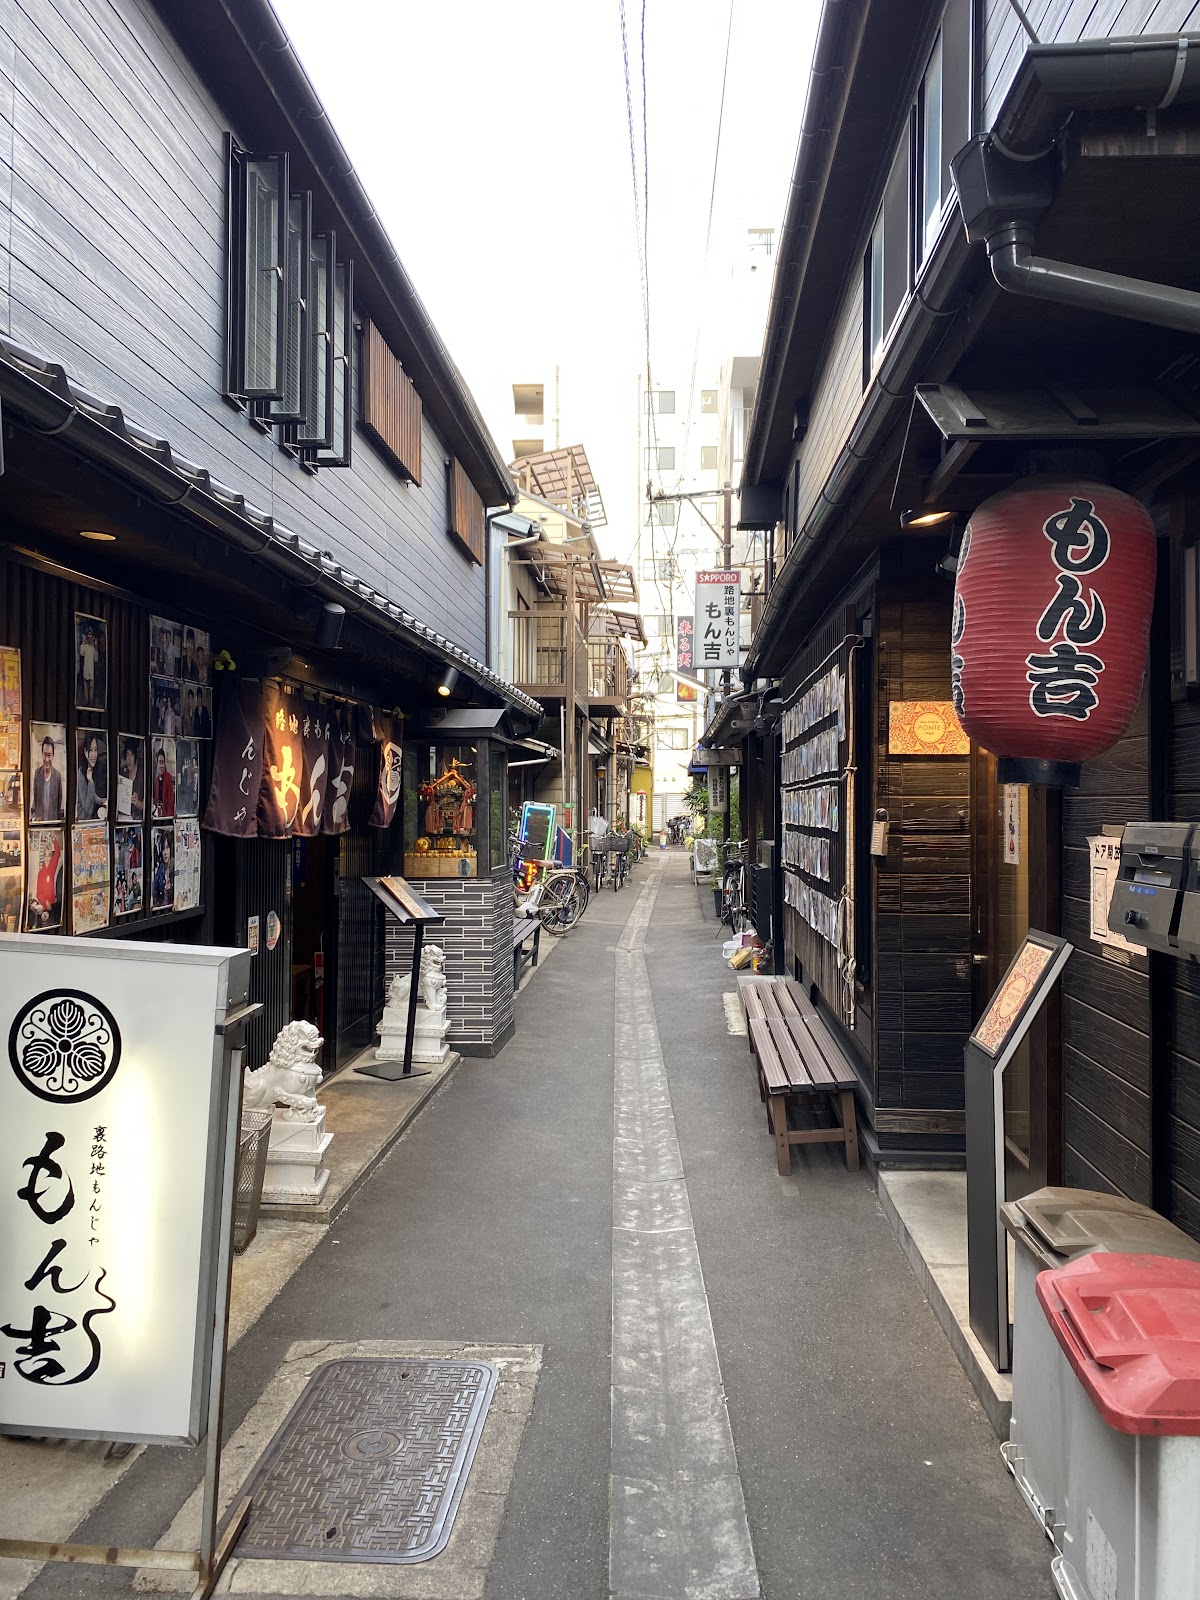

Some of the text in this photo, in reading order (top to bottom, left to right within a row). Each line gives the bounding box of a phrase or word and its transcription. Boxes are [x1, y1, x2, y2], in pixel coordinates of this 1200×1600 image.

[699, 573, 738, 583] SAPPORO
[704, 602, 722, 661] もん吉
[724, 585, 735, 656] 路地裏もんじゃ
[1025, 496, 1112, 721] もん吉
[677, 619, 693, 668] 来る実
[917, 724, 942, 732] PONTE
[0, 1131, 116, 1386] もん吉
